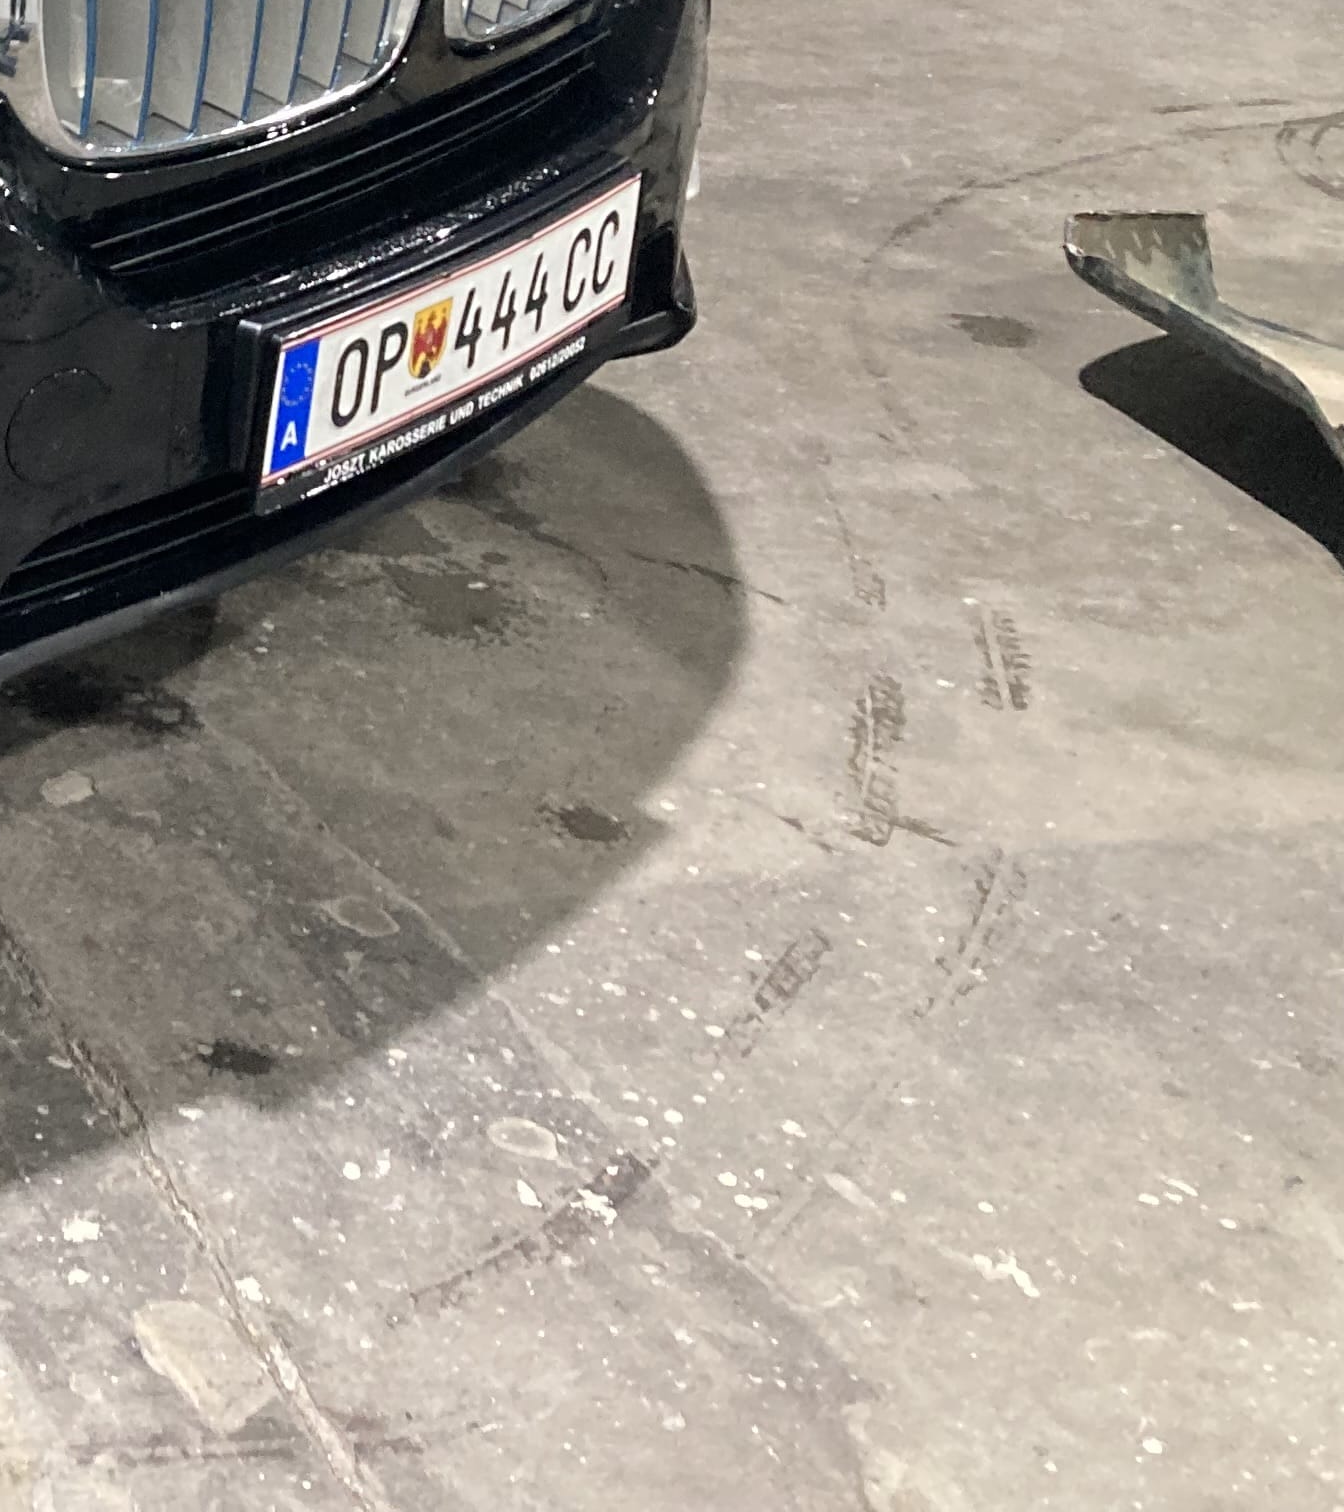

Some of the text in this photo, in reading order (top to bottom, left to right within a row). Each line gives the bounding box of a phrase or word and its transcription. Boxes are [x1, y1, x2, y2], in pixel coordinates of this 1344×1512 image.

[330, 321, 409, 428] OP
[280, 420, 298, 451] A
[323, 453, 365, 483] JOSZT
[369, 414, 447, 461] KAROSSERIE
[449, 399, 474, 426] UND
[477, 374, 524, 410] TECHNIK
